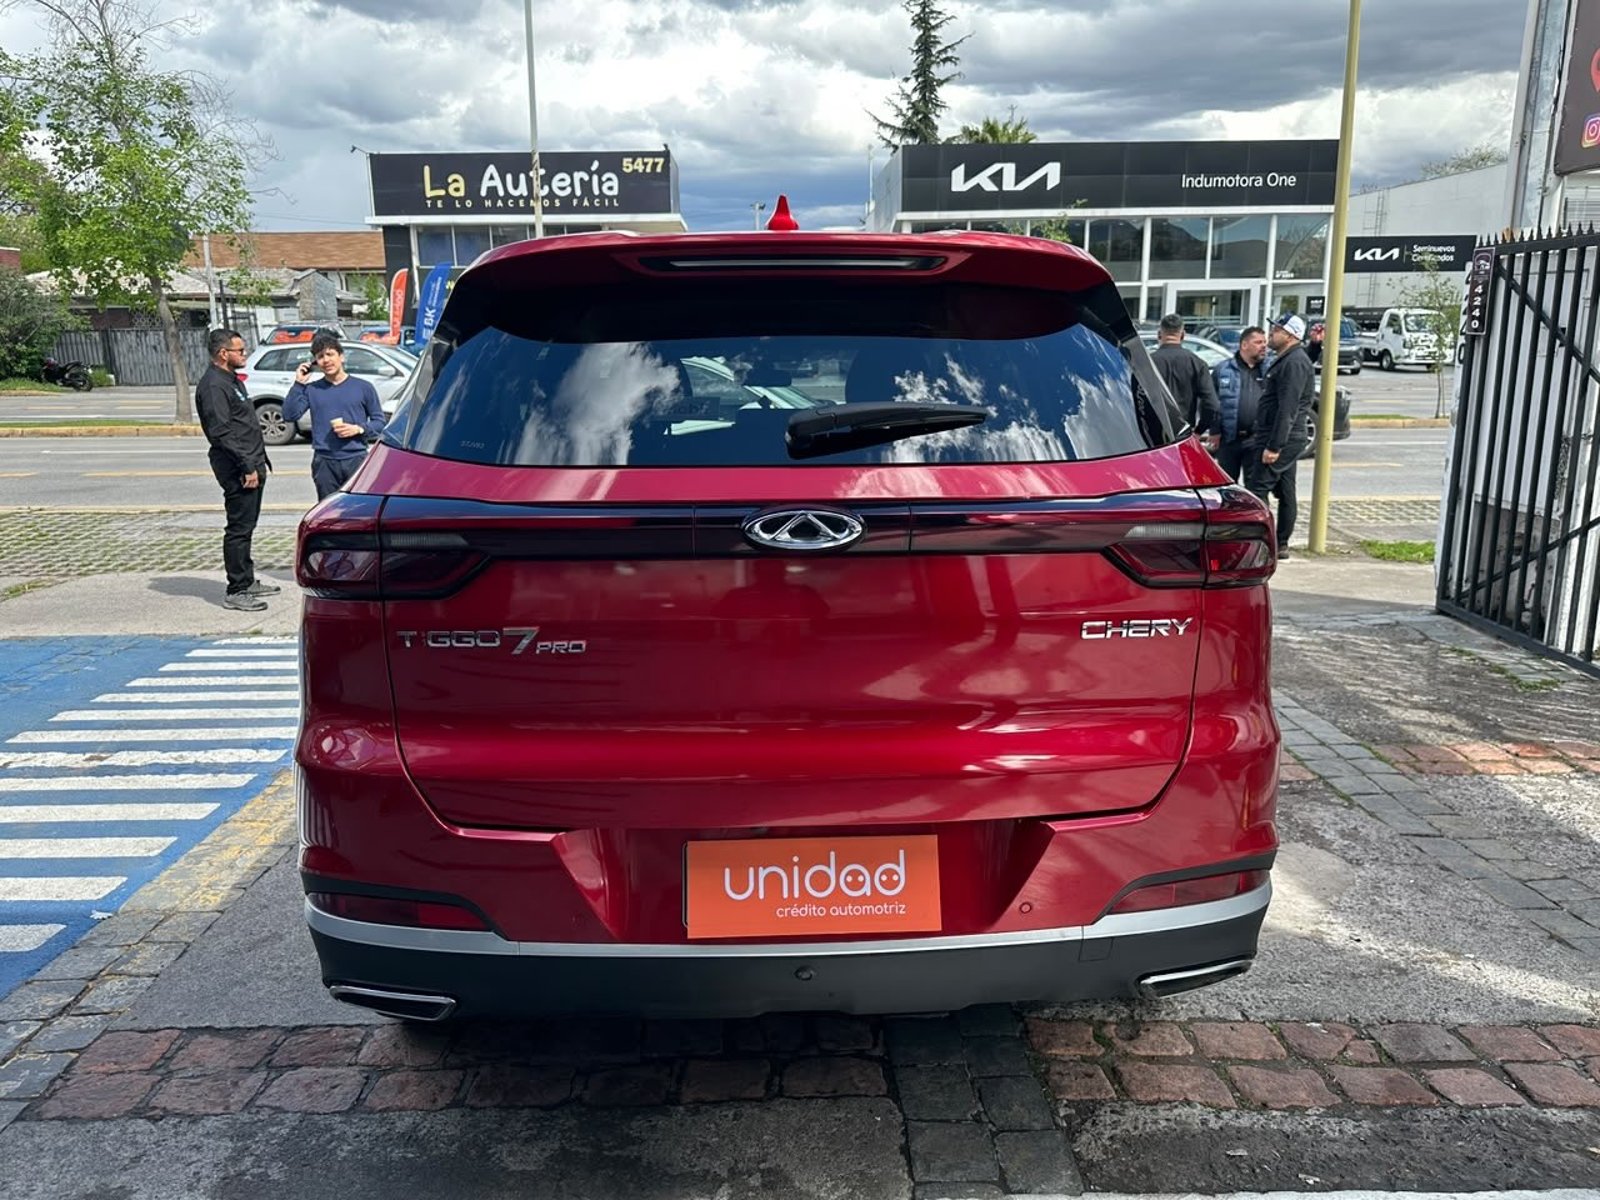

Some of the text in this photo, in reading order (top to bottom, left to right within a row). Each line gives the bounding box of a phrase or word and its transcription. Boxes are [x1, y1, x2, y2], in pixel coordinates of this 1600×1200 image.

[622, 158, 664, 173] 5477
[423, 160, 619, 198] La Autería
[951, 162, 1061, 192] KIA
[1181, 172, 1296, 189] Indumotora One
[426, 200, 443, 208] TE
[455, 200, 473, 208] LO
[573, 197, 620, 207] FÁCIL
[1354, 247, 1400, 260] KIA
[1413, 244, 1455, 253] Seminuevos
[1471, 284, 1484, 329] 4240
[1081, 617, 1193, 639] CHERY
[502, 626, 540, 655] 7
[535, 640, 587, 654] PRO
[724, 849, 906, 901] unidad
[776, 901, 907, 918] crédito automotriz
